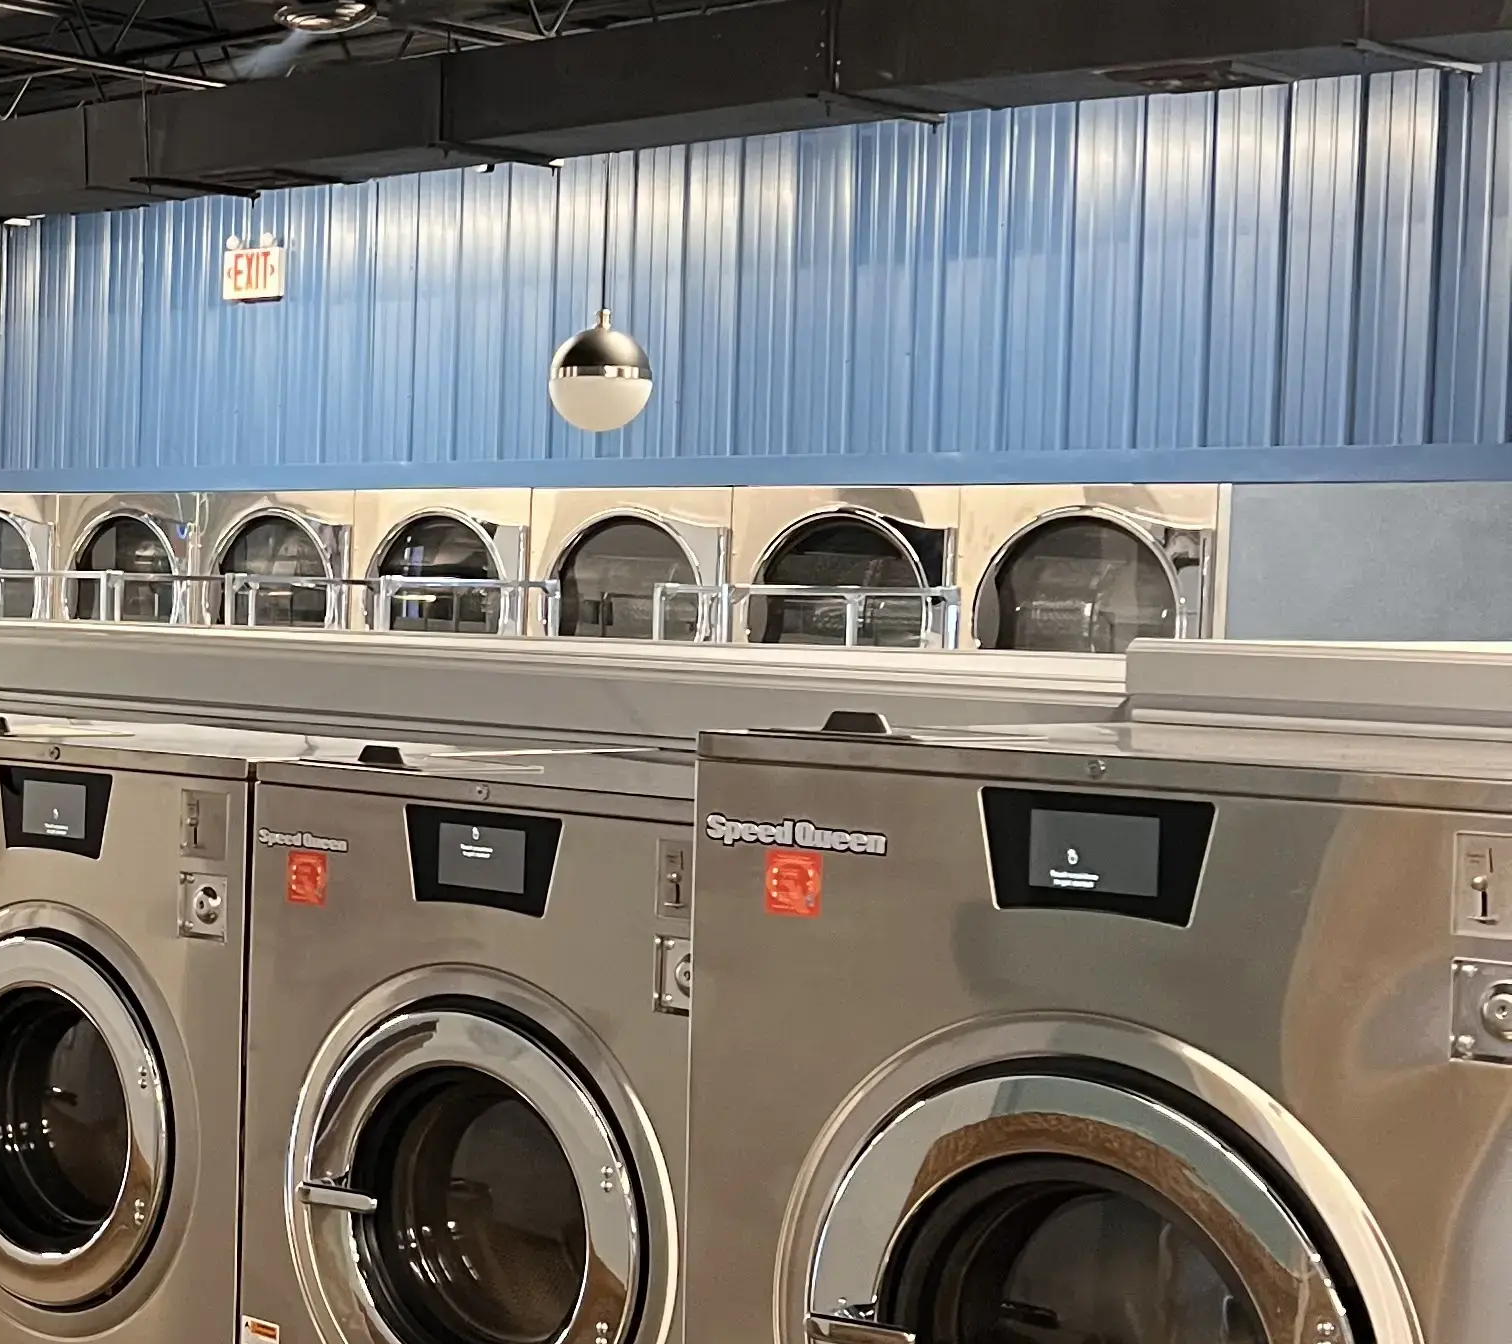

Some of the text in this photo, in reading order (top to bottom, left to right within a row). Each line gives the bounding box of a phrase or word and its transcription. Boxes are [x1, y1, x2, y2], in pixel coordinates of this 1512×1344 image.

[234, 252, 270, 291] EXIT
[258, 827, 348, 853] Speed Queen
[706, 812, 887, 856] Speed Queen
